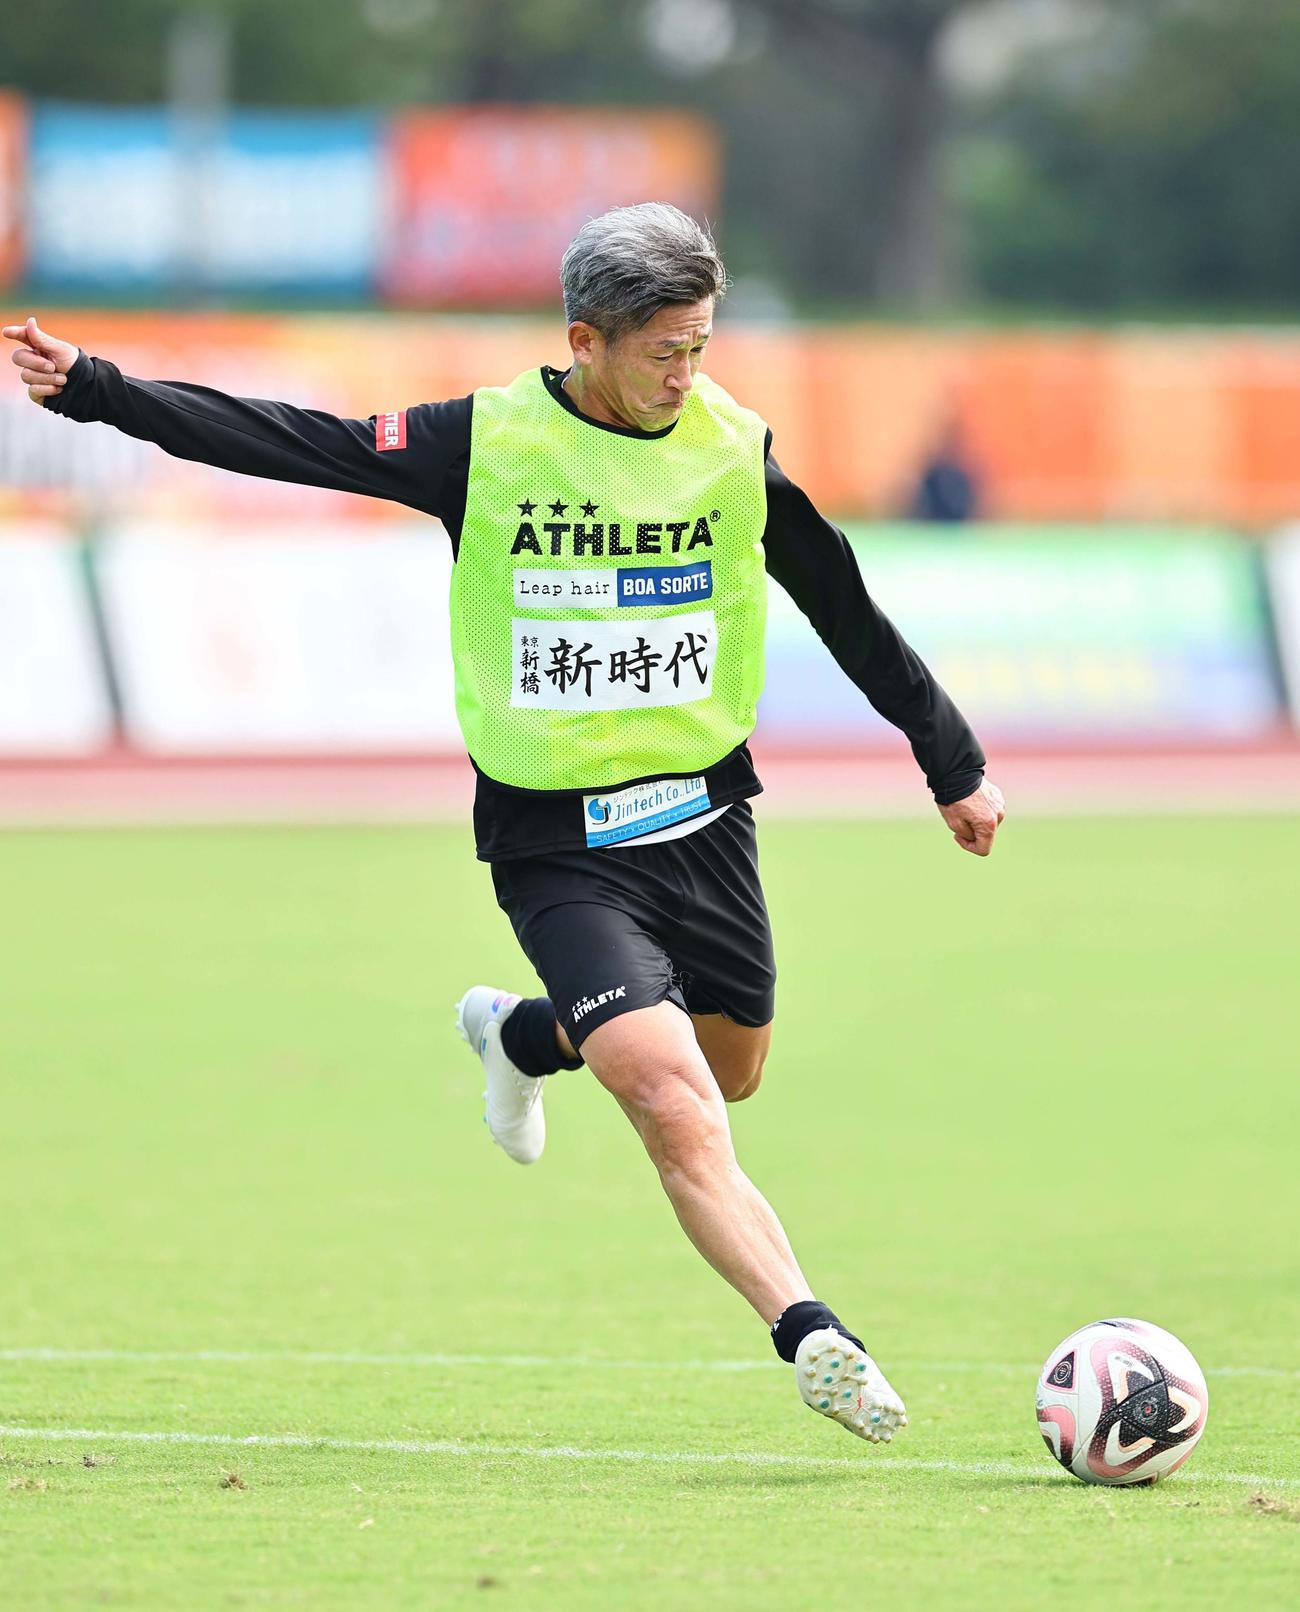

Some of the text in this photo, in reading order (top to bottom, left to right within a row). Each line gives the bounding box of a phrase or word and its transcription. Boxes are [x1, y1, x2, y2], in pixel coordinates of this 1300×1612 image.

[385, 411, 399, 448] TIER
[519, 580, 611, 597] Leap hair
[623, 571, 709, 596] BOA SORTE
[520, 635, 539, 648] 東京
[519, 648, 541, 695] 新橋
[544, 632, 709, 698] 新時代
[614, 789, 664, 822] Jintech
[596, 827, 629, 843] SAFETY
[637, 812, 672, 831] QUALITY
